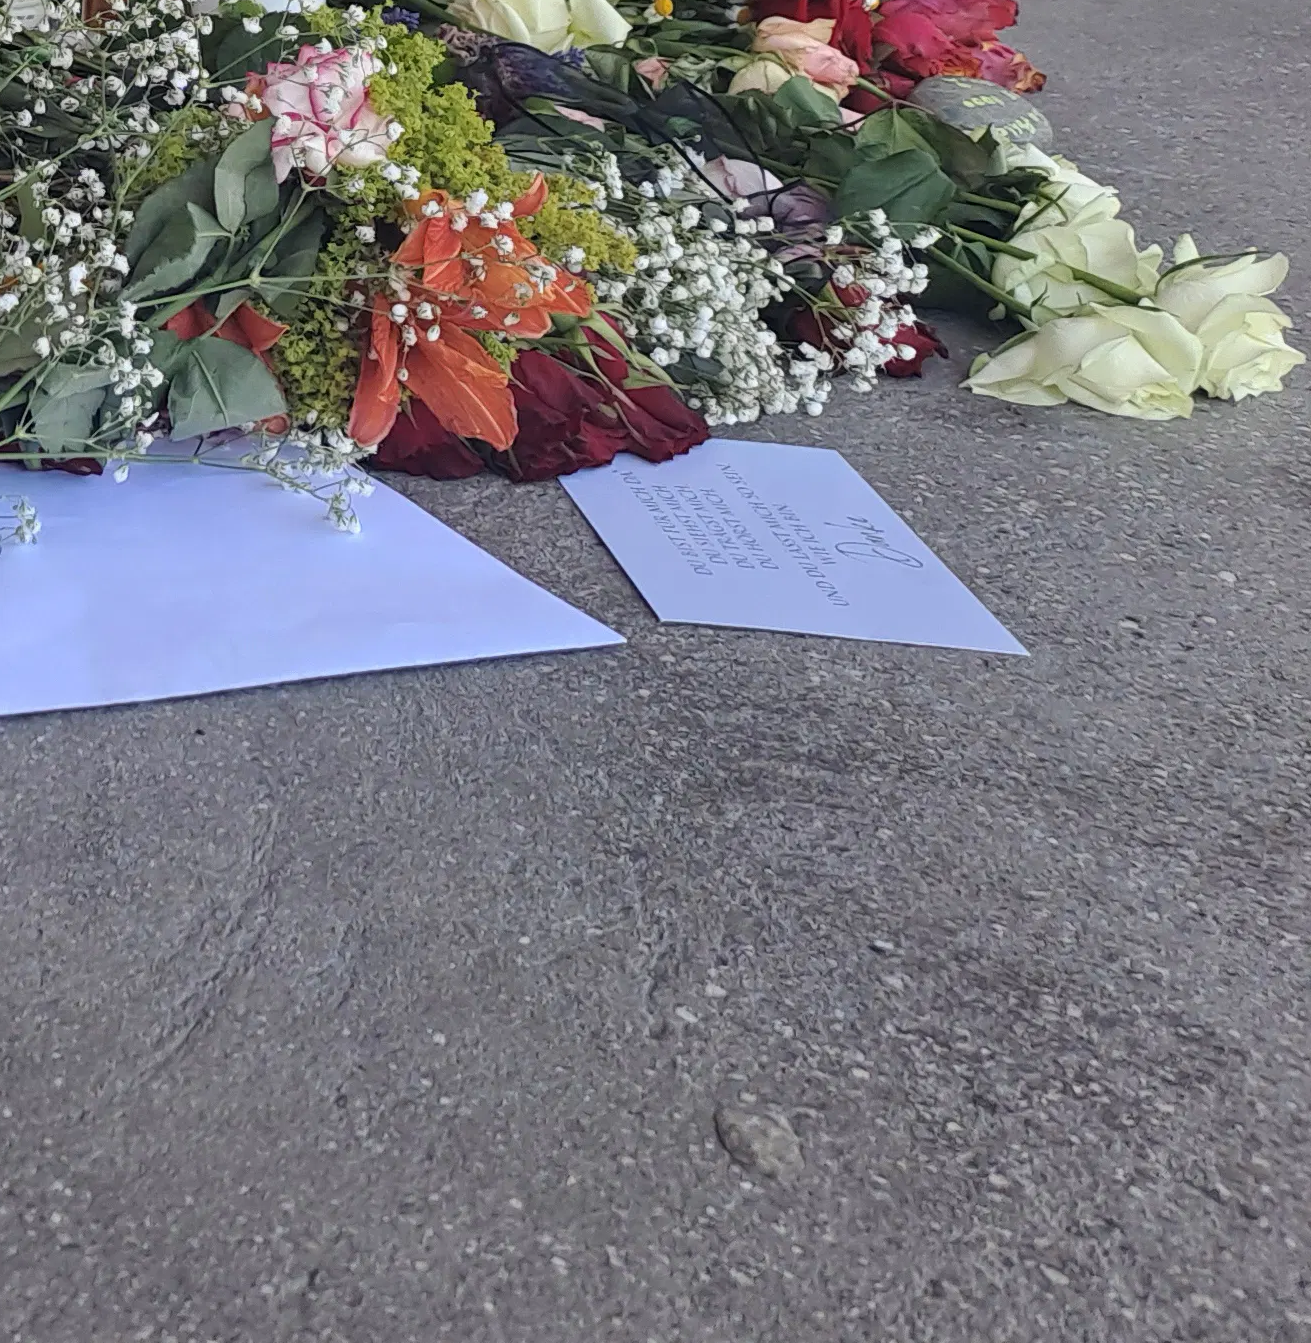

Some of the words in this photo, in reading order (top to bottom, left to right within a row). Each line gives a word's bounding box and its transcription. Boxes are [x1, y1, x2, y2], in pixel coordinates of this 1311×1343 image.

[628, 485, 665, 514] MICH
[734, 485, 760, 500] SO
[746, 500, 785, 530] MICH
[671, 511, 715, 547] SIEHST
[786, 522, 821, 544] ICH
[666, 533, 699, 558] BIST
[700, 547, 729, 565] DU
[806, 544, 838, 565] WIE
[685, 558, 714, 576] DU
[727, 551, 756, 570] DU
[750, 552, 780, 570] DU
[796, 560, 827, 579] DU
[814, 579, 851, 607] UND
